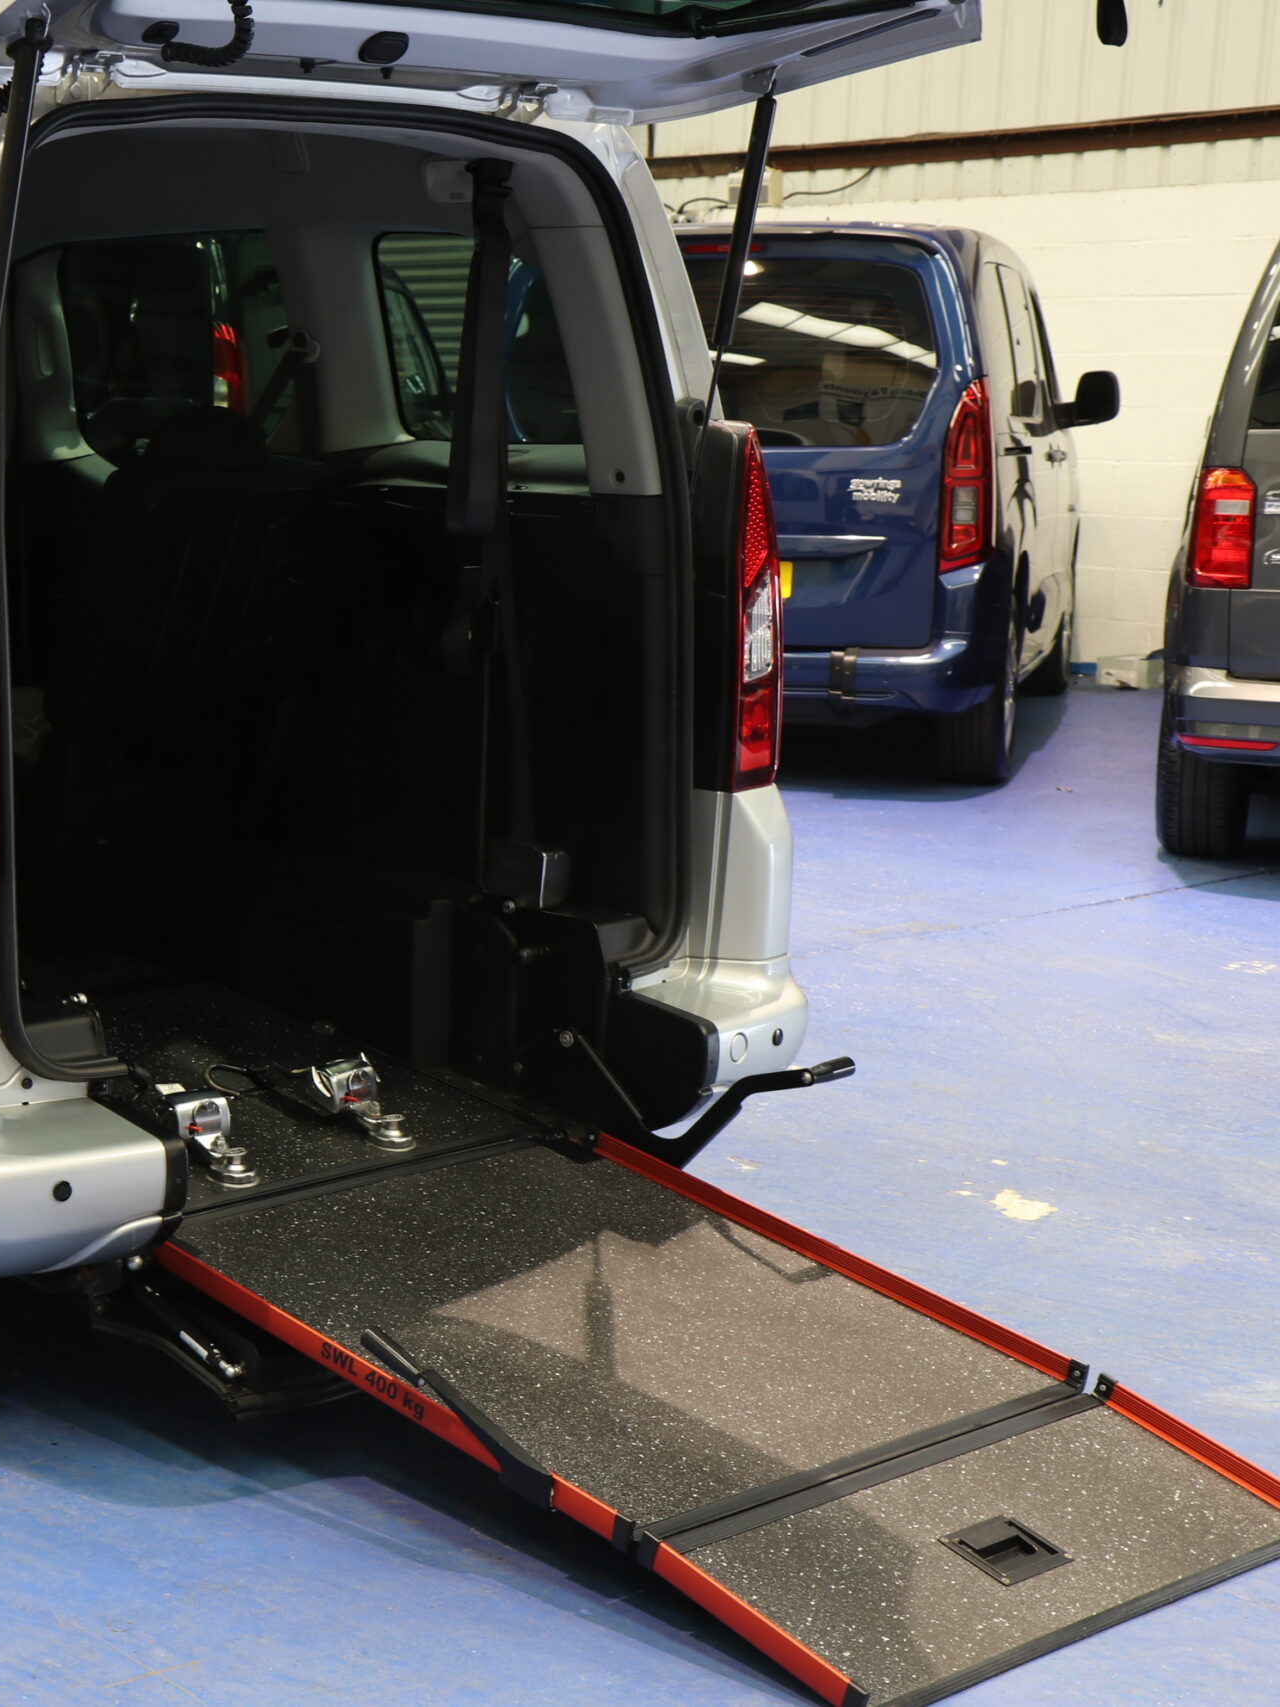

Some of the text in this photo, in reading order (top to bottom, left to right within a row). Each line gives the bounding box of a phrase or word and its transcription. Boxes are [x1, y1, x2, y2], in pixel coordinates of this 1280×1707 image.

[852, 490, 900, 503] mobility
[321, 1342, 425, 1420] SWL 400 kg
